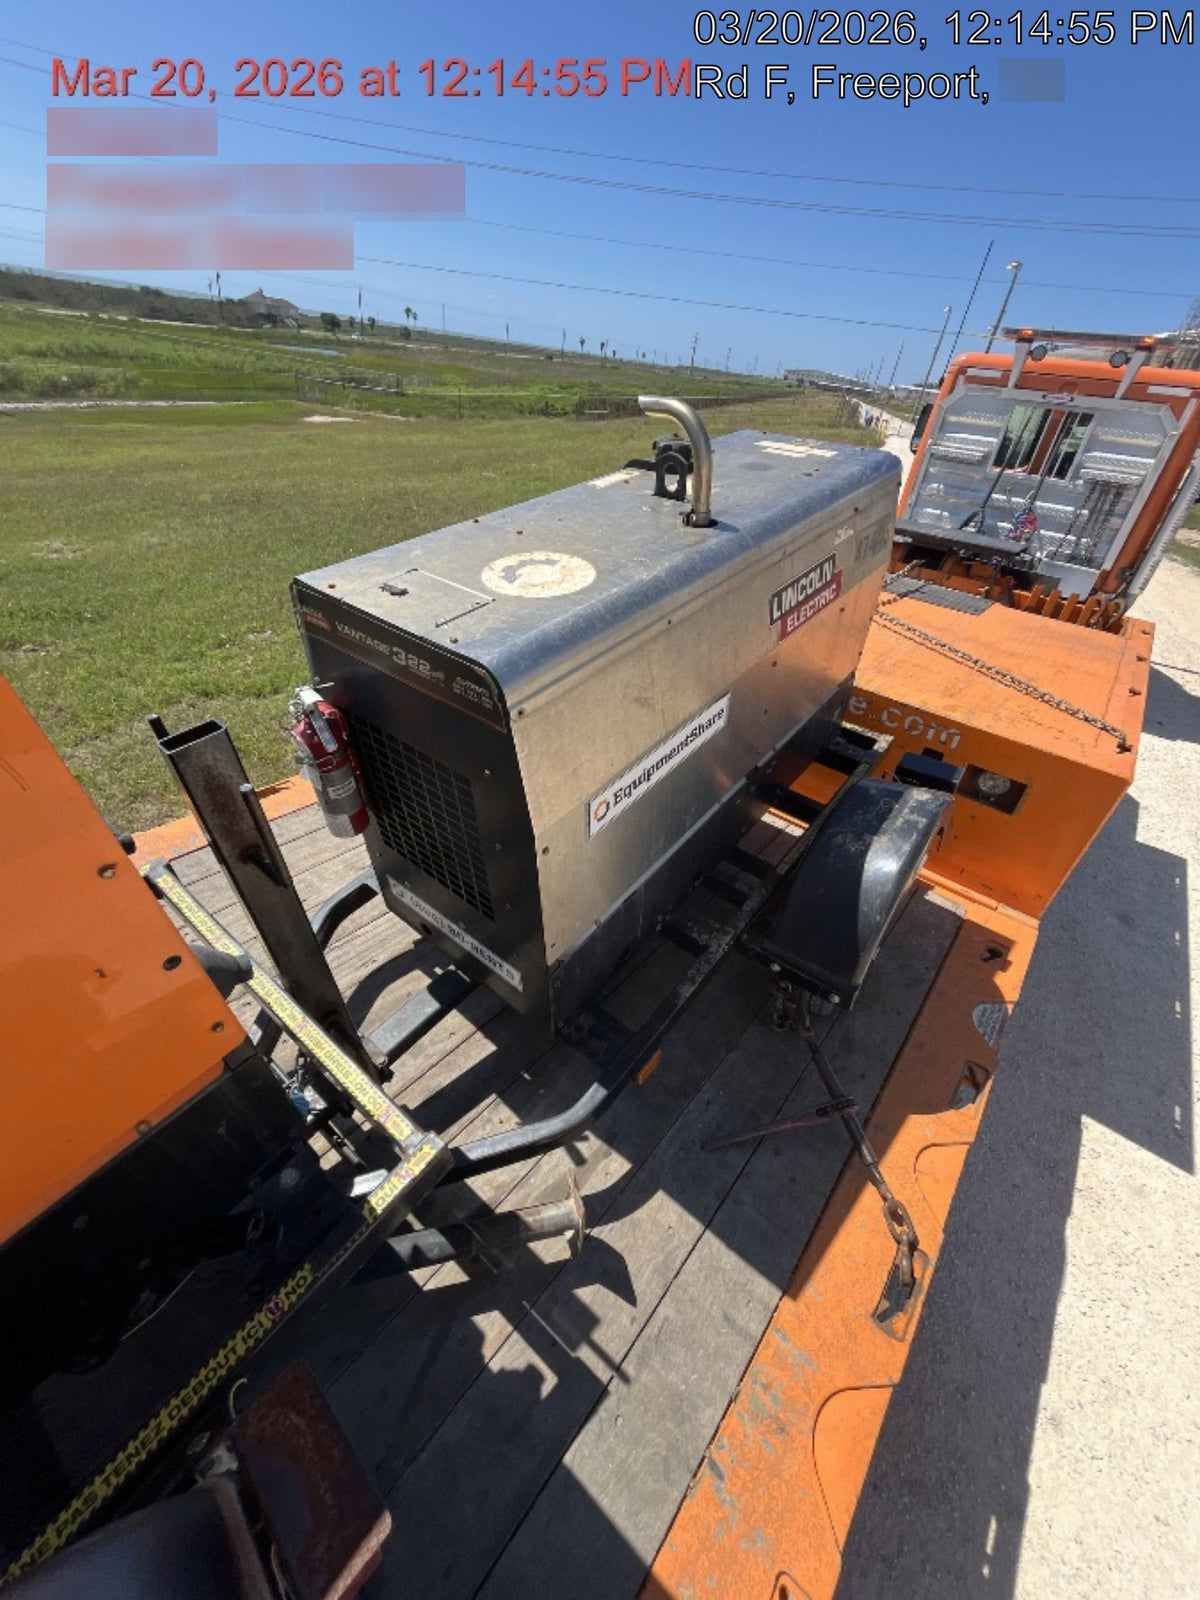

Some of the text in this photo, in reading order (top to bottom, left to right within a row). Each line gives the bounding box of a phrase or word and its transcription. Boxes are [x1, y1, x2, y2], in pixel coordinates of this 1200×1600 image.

[772, 559, 833, 621] LINCOLN
[786, 583, 837, 632] ELECTRIC
[336, 621, 390, 656] VANTAGE
[613, 707, 725, 806] EquipmentShare
[100, 1422, 164, 1487] TENEZ
[165, 1344, 239, 1421] DEBOUT
[239, 1317, 266, 1345] ICI
[283, 1272, 308, 1301] NO
